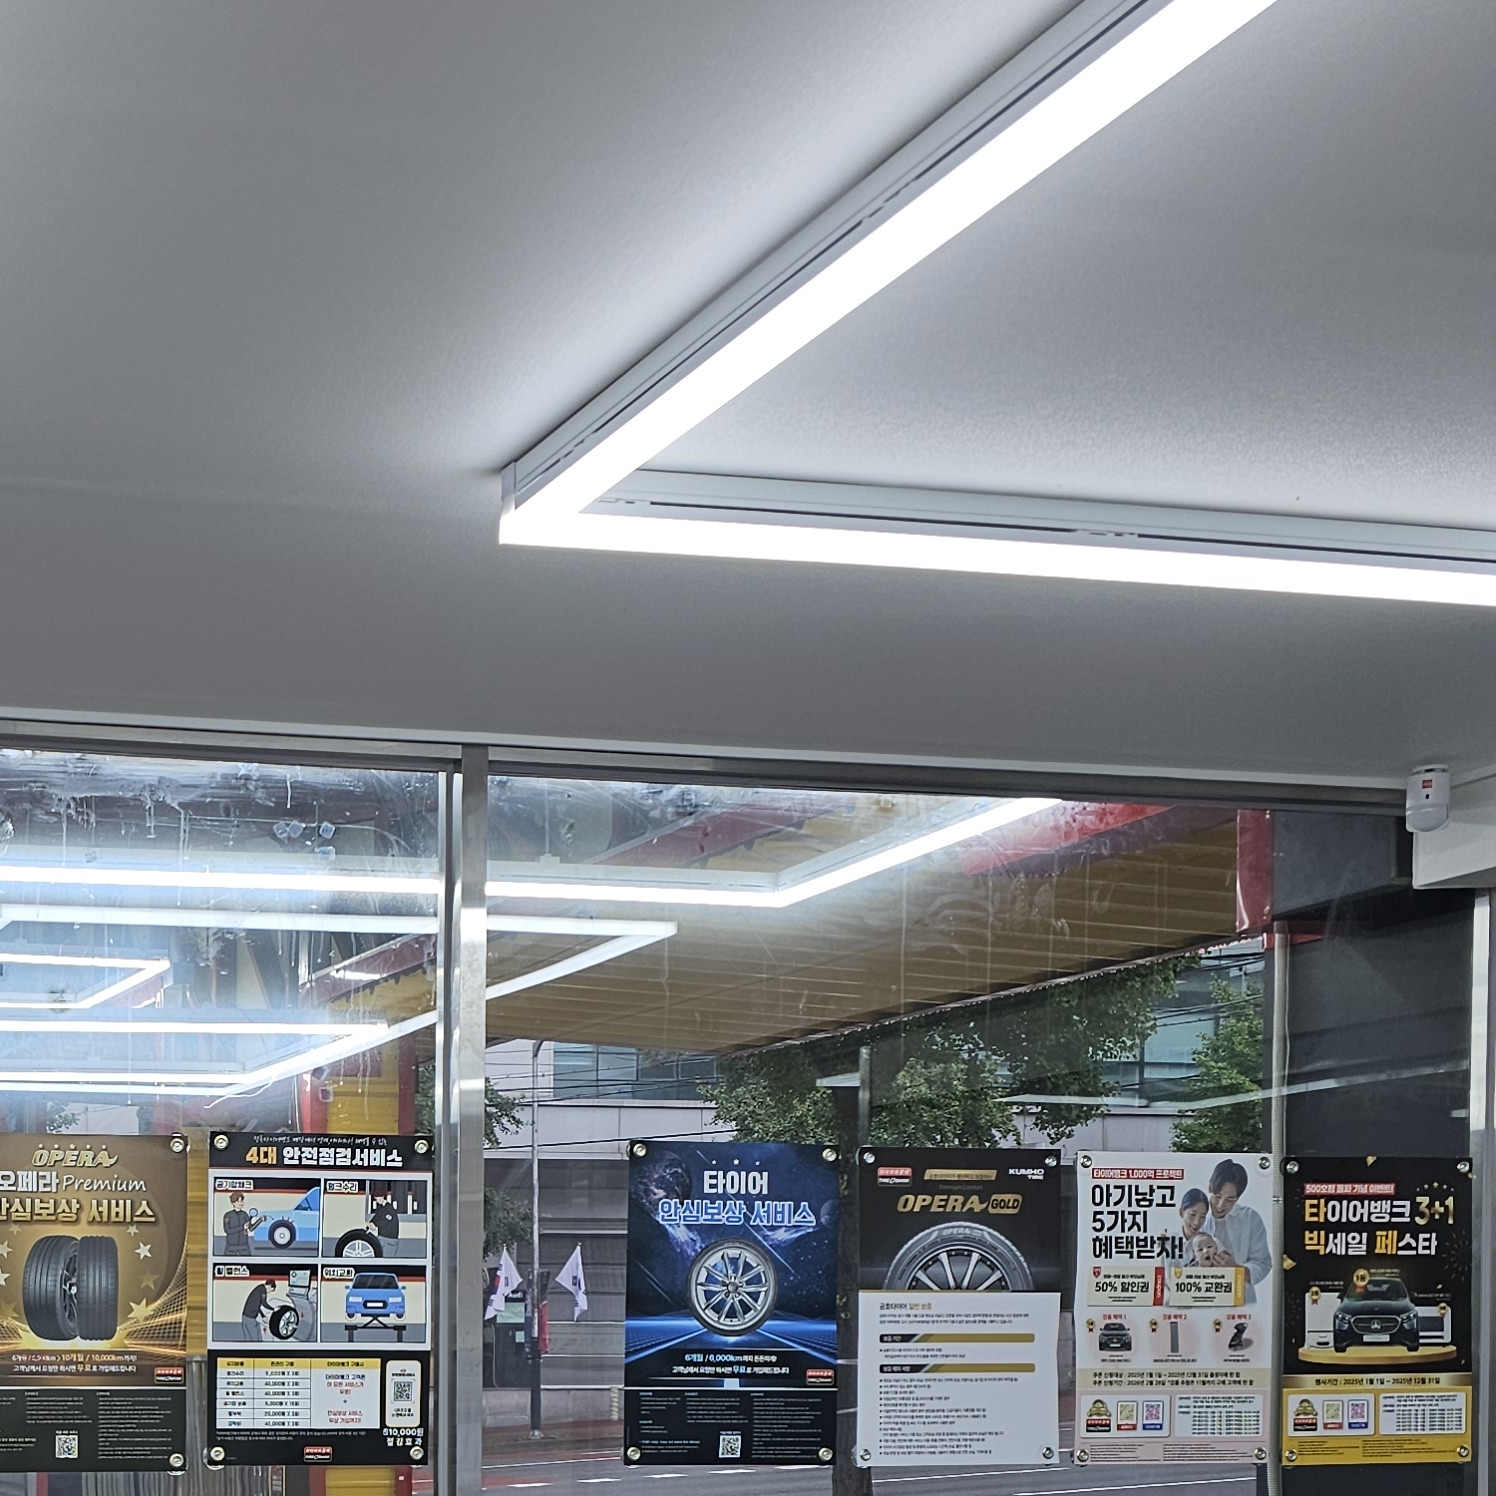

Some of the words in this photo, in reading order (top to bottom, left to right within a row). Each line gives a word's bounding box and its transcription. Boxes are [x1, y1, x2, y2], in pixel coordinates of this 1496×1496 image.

[32, 1149, 118, 1167] OPERA
[246, 1147, 276, 1164] 4대
[283, 1147, 403, 1166] 안전점검서비스
[62, 1174, 146, 1193] Premium
[703, 1170, 769, 1195] 타이어
[897, 1194, 988, 1212] OPERA
[991, 1199, 1020, 1209] GOLD
[1092, 1184, 1176, 1208] 아기낳고
[87, 1200, 156, 1223] 서비스
[659, 1199, 745, 1225] 안심보상
[750, 1201, 816, 1226] 서비스
[1092, 1210, 1148, 1233] 5가지
[1305, 1199, 1410, 1222] 타이어뱅크
[1415, 1196, 1454, 1225] 3+1
[1092, 1236, 1183, 1260] 혜택받자!
[1305, 1231, 1367, 1255] 빅세일
[1375, 1231, 1437, 1255] 페스타
[1095, 1282, 1117, 1292] 50%
[1121, 1282, 1149, 1293] 할인권
[1175, 1282, 1202, 1293] 100%
[1204, 1282, 1232, 1293] 교환권
